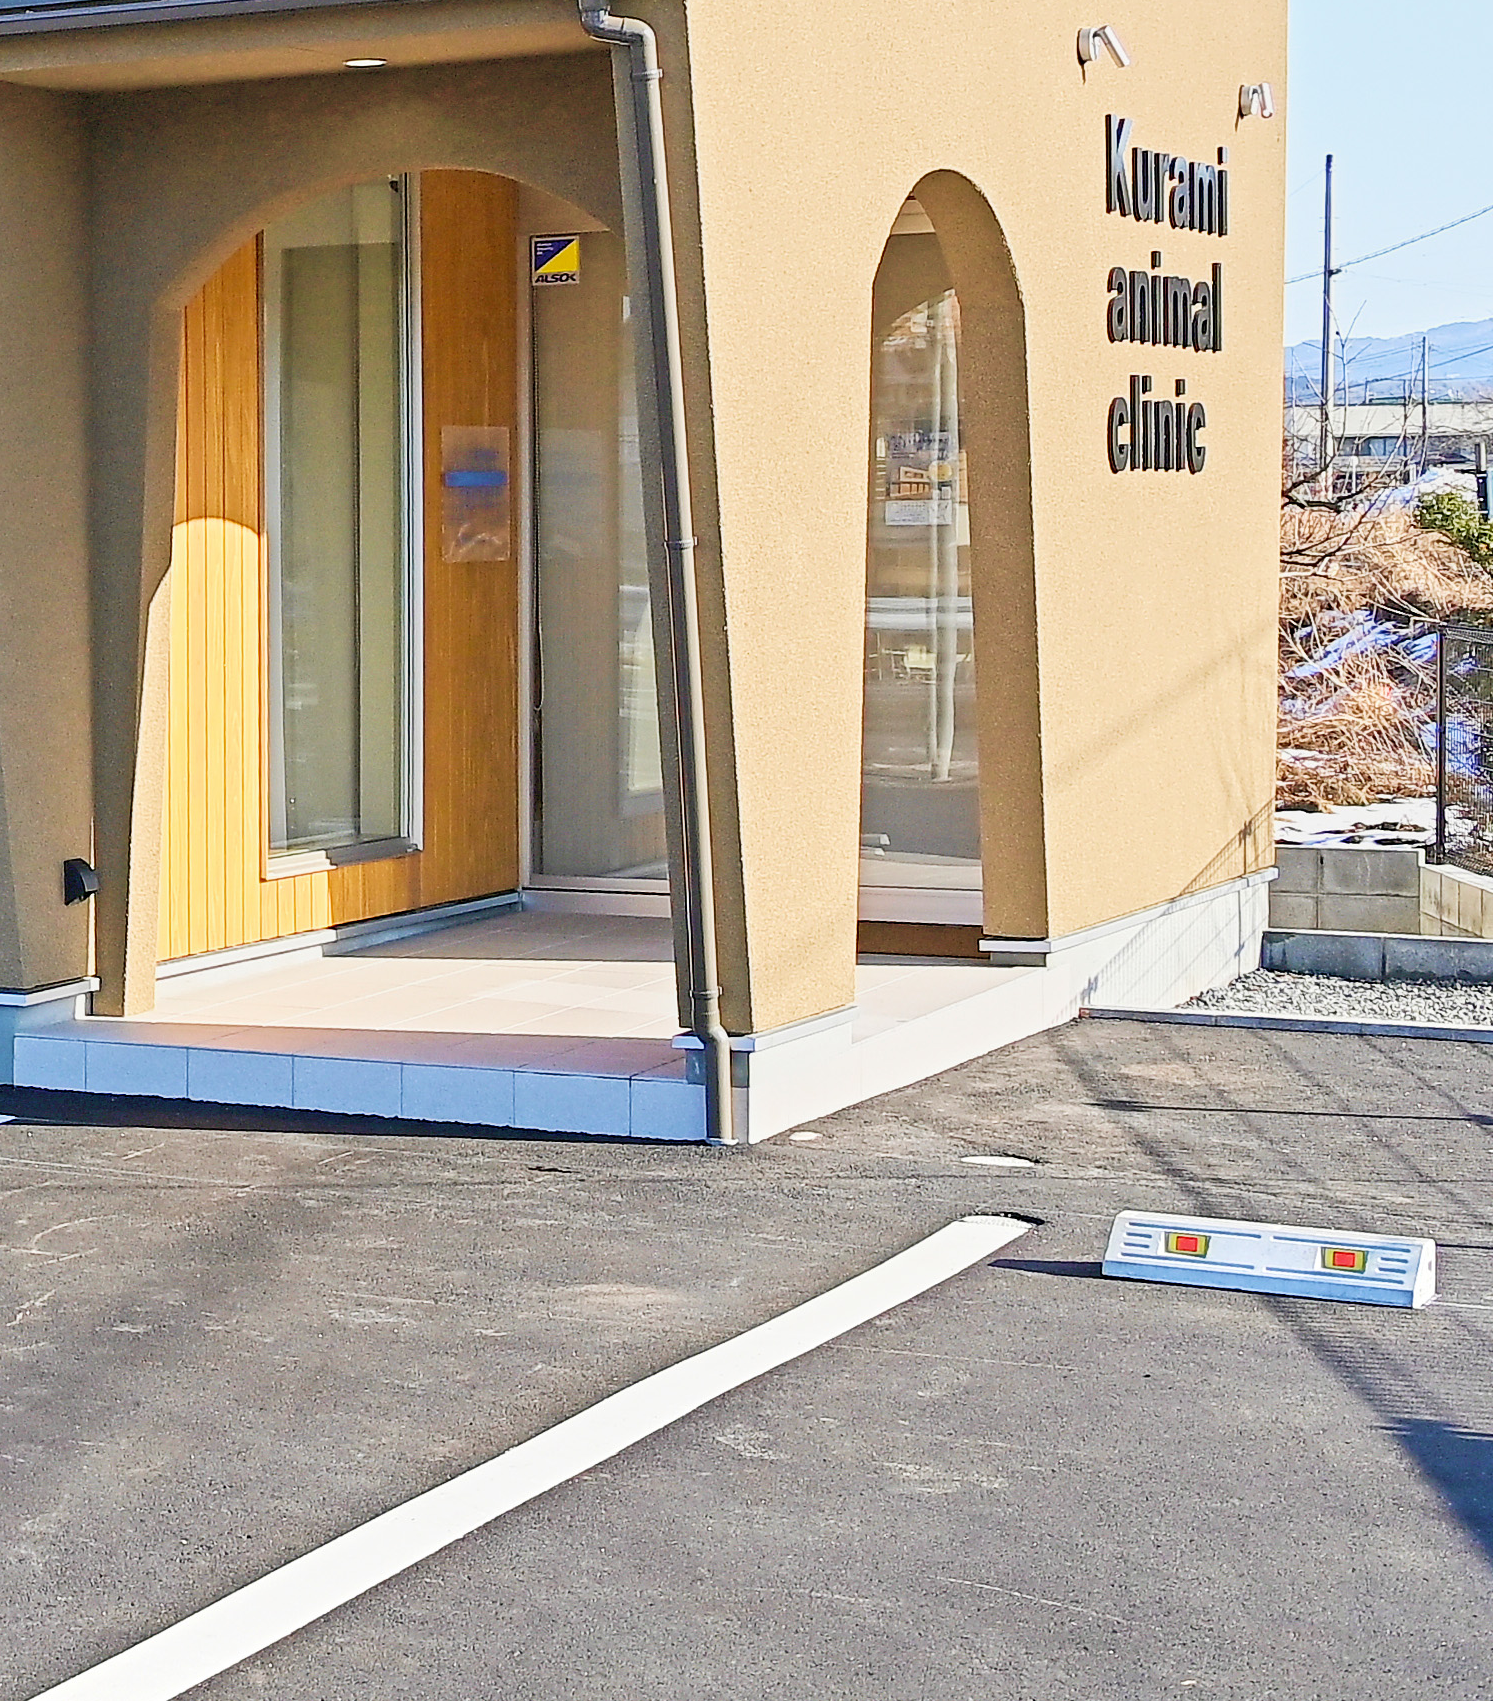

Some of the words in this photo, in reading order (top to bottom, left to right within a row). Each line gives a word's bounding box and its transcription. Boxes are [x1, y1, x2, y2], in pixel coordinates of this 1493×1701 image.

[1105, 114, 1228, 236] Kurami
[534, 273, 576, 284] ALSOK
[1107, 250, 1222, 352] animal
[1107, 375, 1206, 473] clinic
